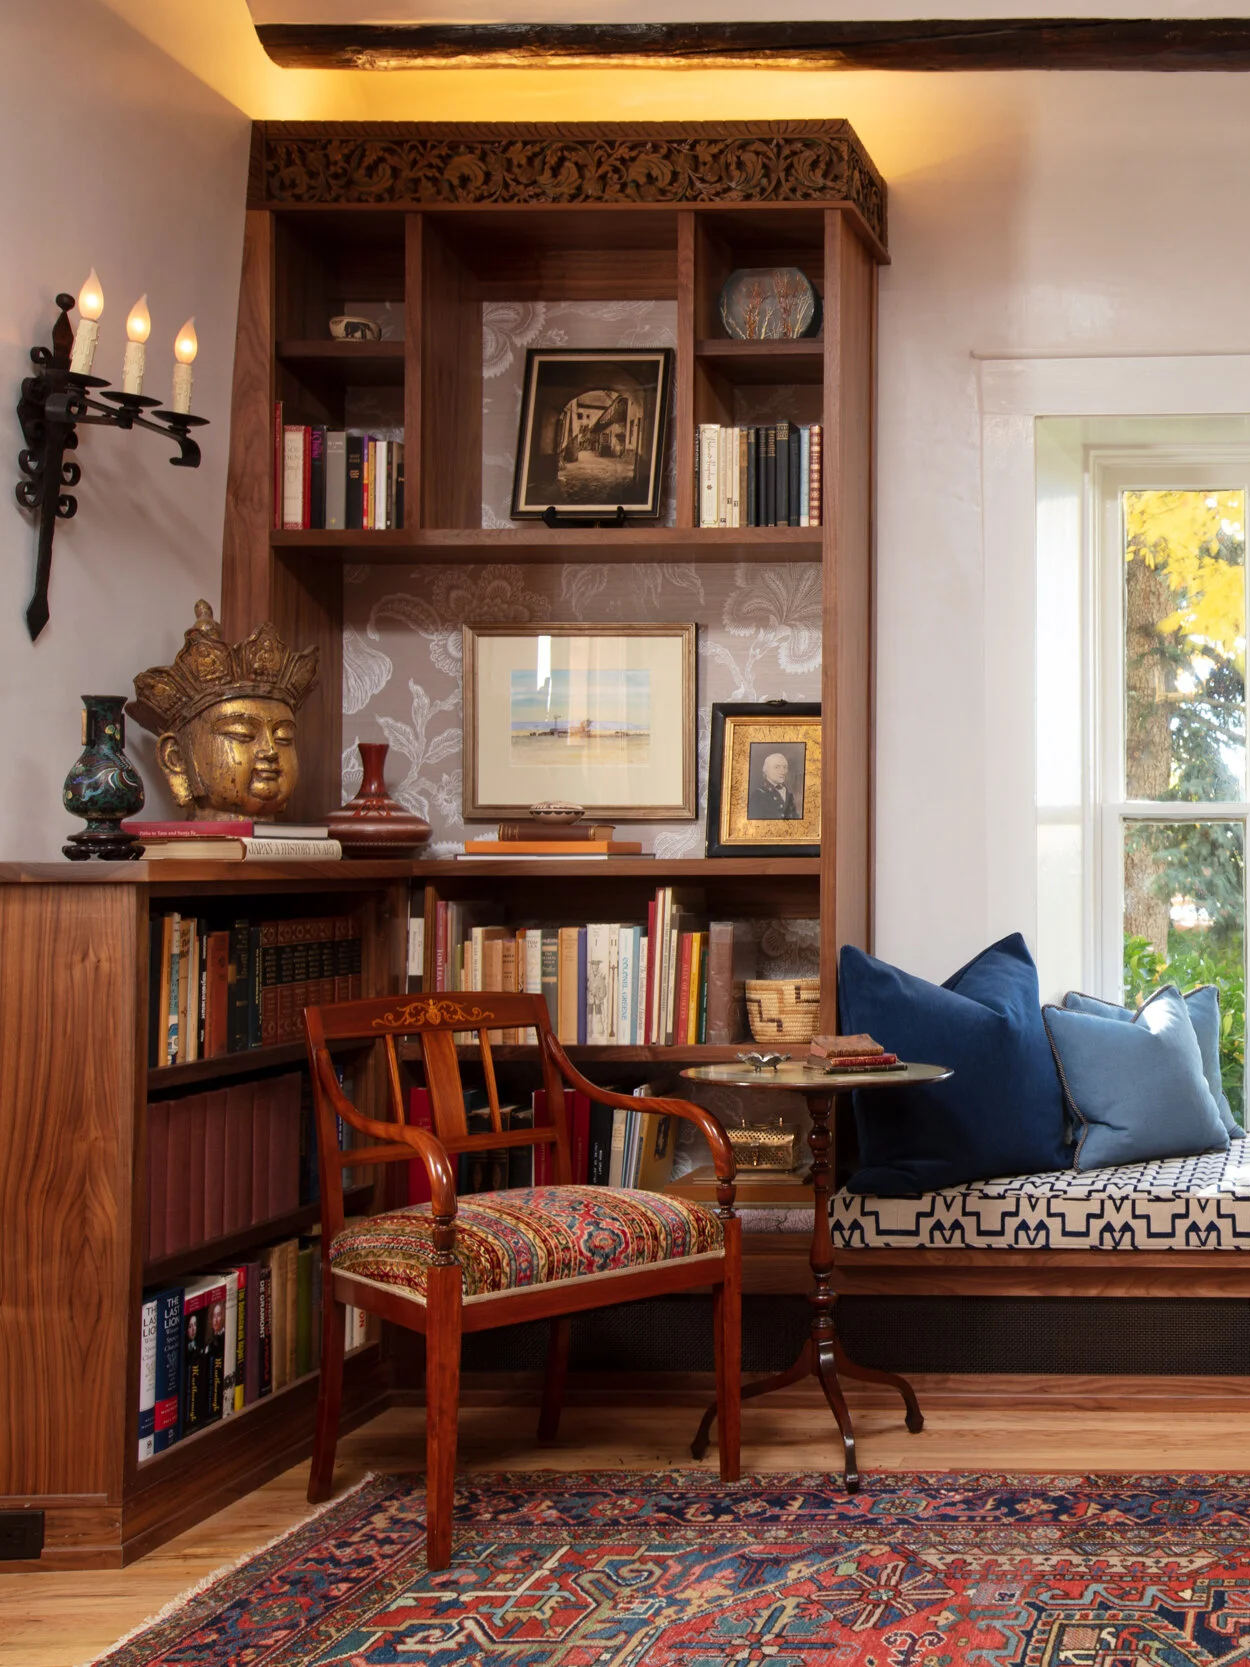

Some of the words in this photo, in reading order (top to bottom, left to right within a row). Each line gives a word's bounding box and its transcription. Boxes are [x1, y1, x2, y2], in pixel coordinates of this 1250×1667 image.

[248, 843, 272, 856] JAPAN
[274, 843, 280, 855] A
[281, 843, 311, 855] HISTORY
[313, 844, 321, 855] IN
[322, 844, 336, 856] ART
[260, 1280, 264, 1293] DE
[167, 1296, 179, 1308] THE
[165, 1306, 180, 1318] LAST
[164, 1316, 180, 1329] LION
